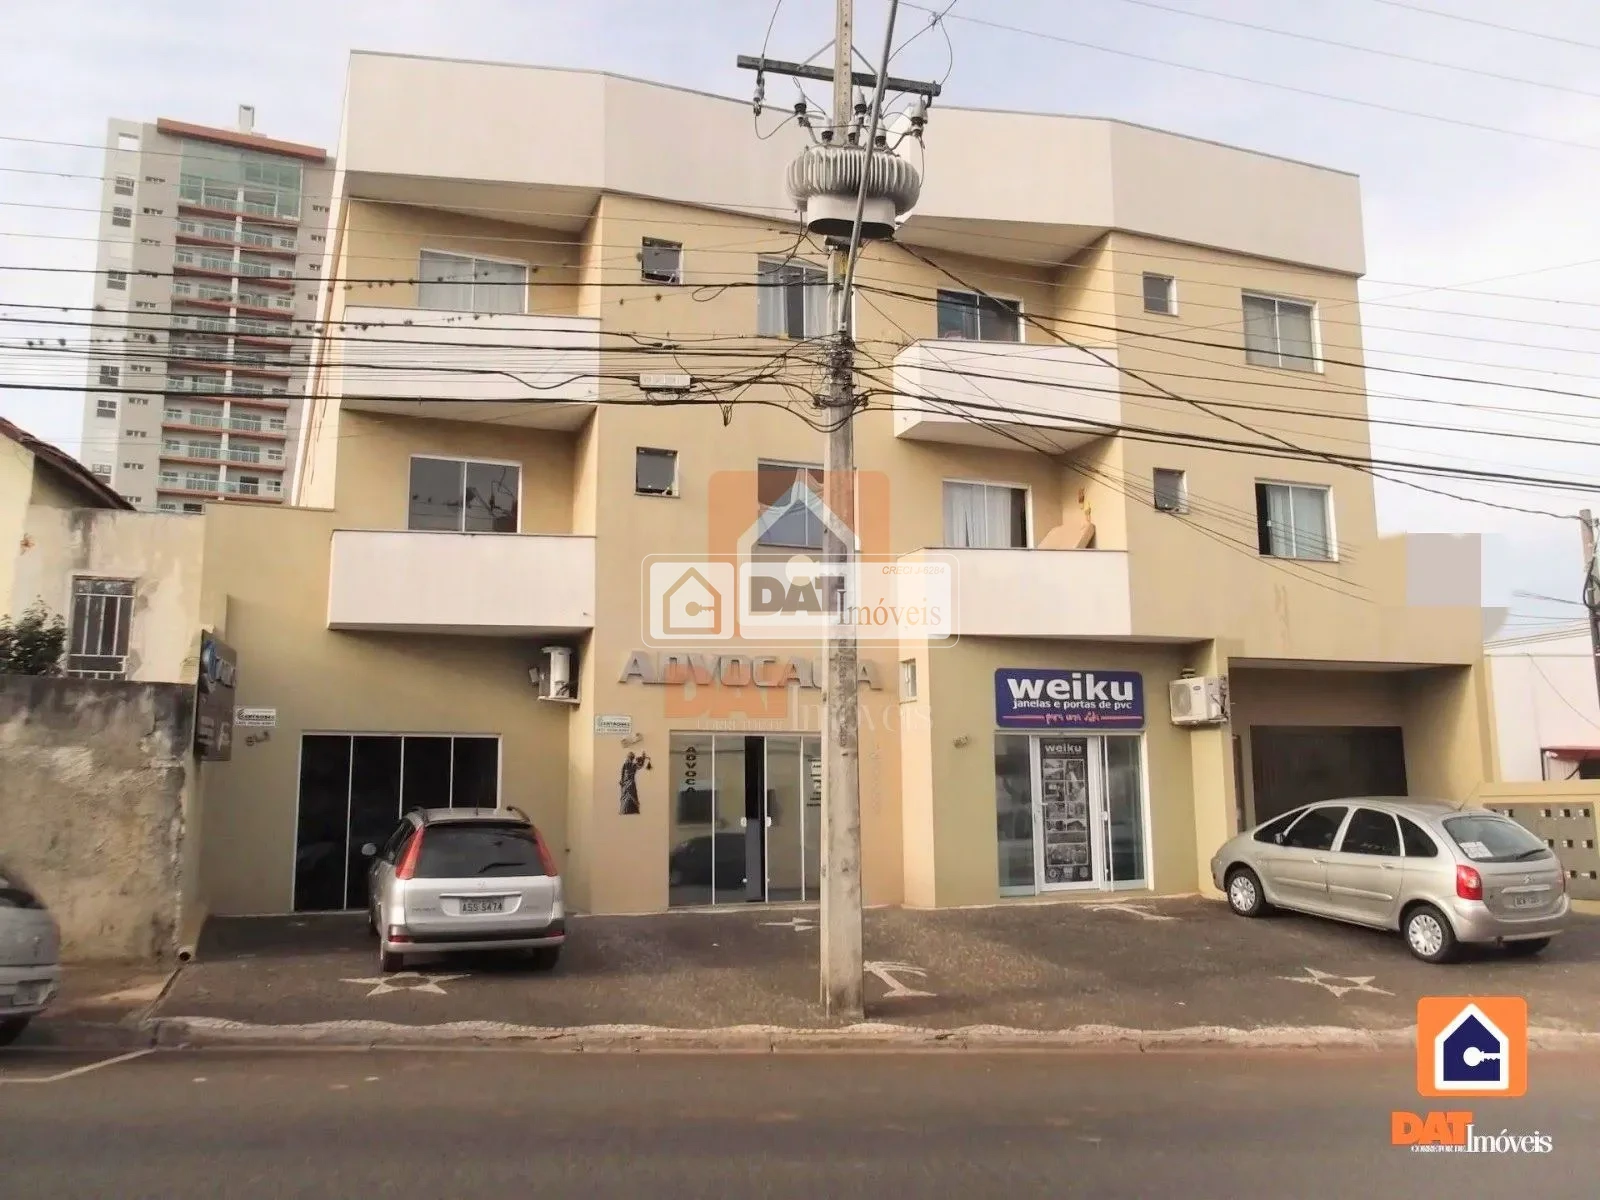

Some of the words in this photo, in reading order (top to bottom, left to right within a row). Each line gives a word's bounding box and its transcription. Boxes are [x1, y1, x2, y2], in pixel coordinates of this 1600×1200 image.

[618, 650, 884, 691] ADVOCAA
[1007, 672, 1134, 701] weiku
[1012, 699, 1052, 710] janelas
[1053, 700, 1061, 709] e
[1063, 700, 1097, 711] portas
[1098, 700, 1112, 709] de
[1114, 702, 1133, 711] pvc
[1044, 743, 1083, 753] weiku
